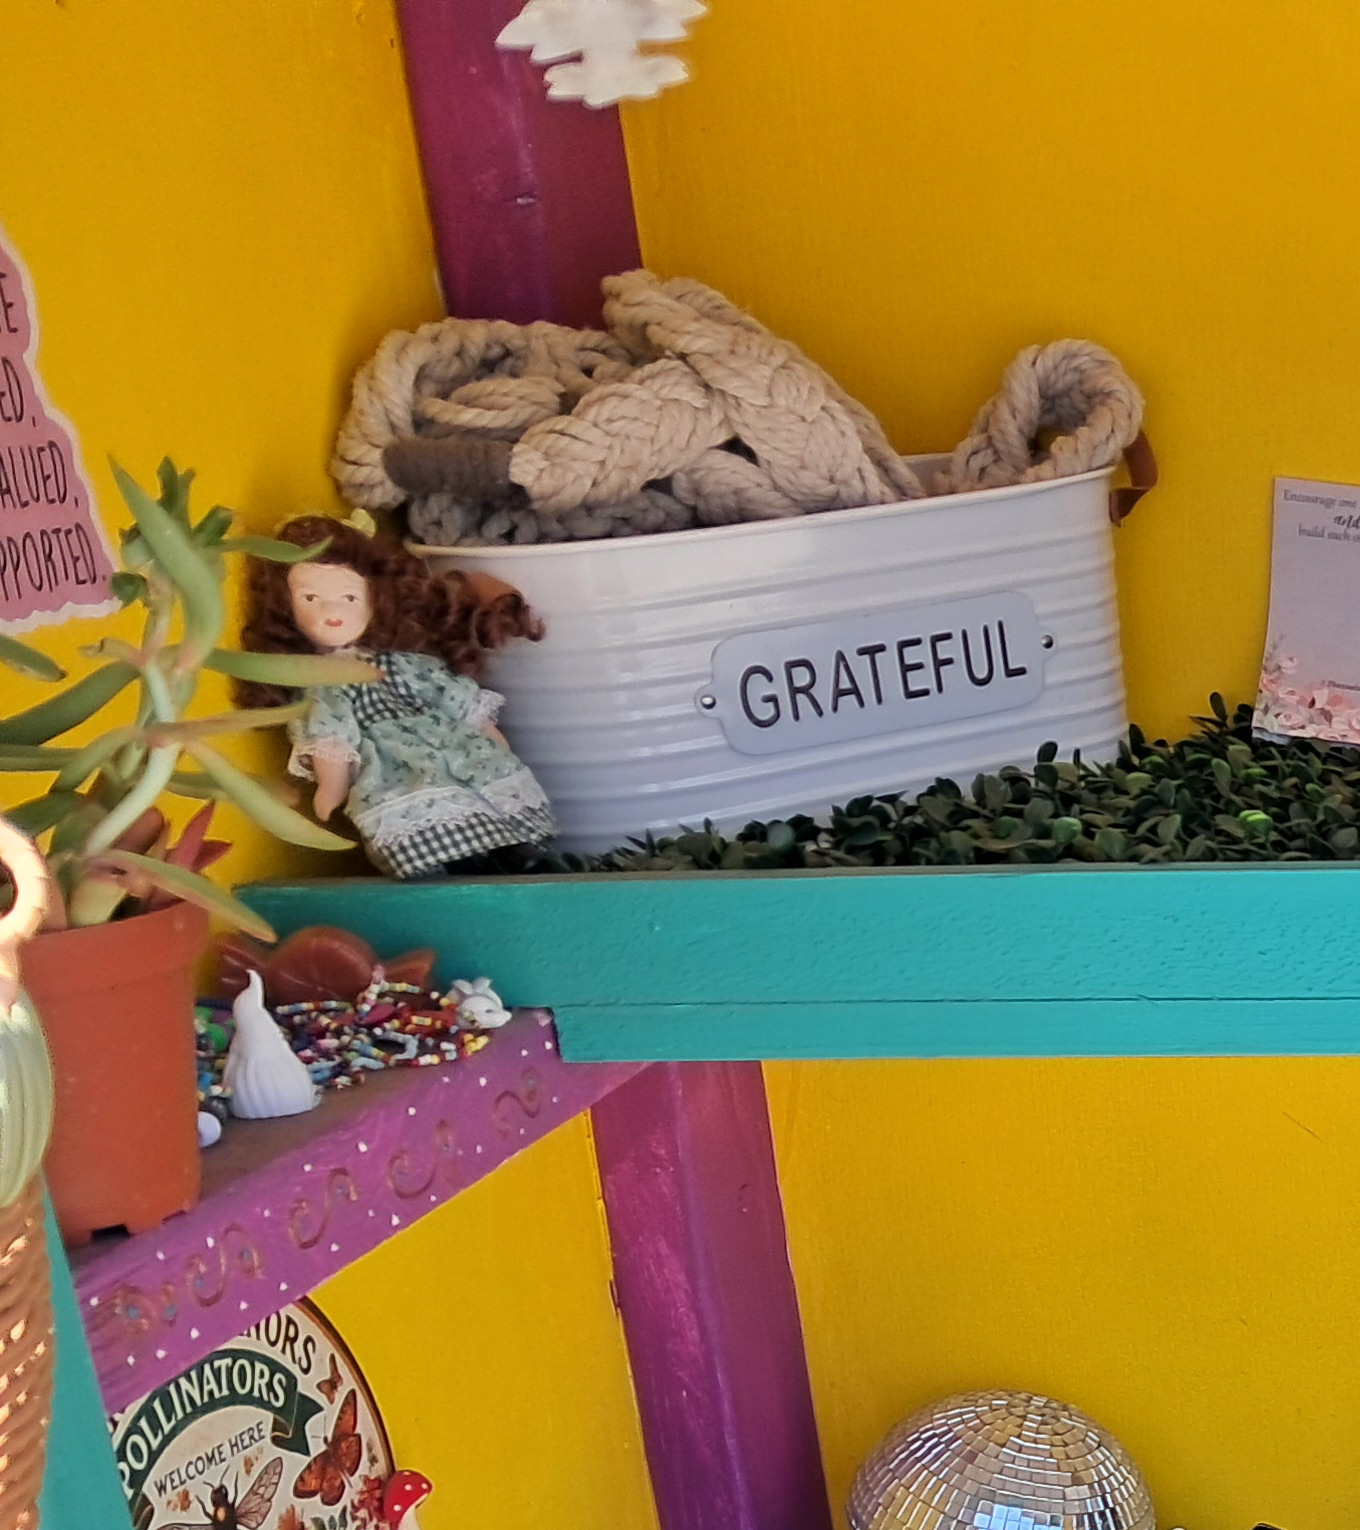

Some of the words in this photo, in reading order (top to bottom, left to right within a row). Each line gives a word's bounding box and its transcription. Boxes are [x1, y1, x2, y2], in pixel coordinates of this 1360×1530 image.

[739, 619, 1027, 728] GRATEFUL
[154, 1443, 226, 1498] WELCOME
[228, 1421, 266, 1456] HERE
